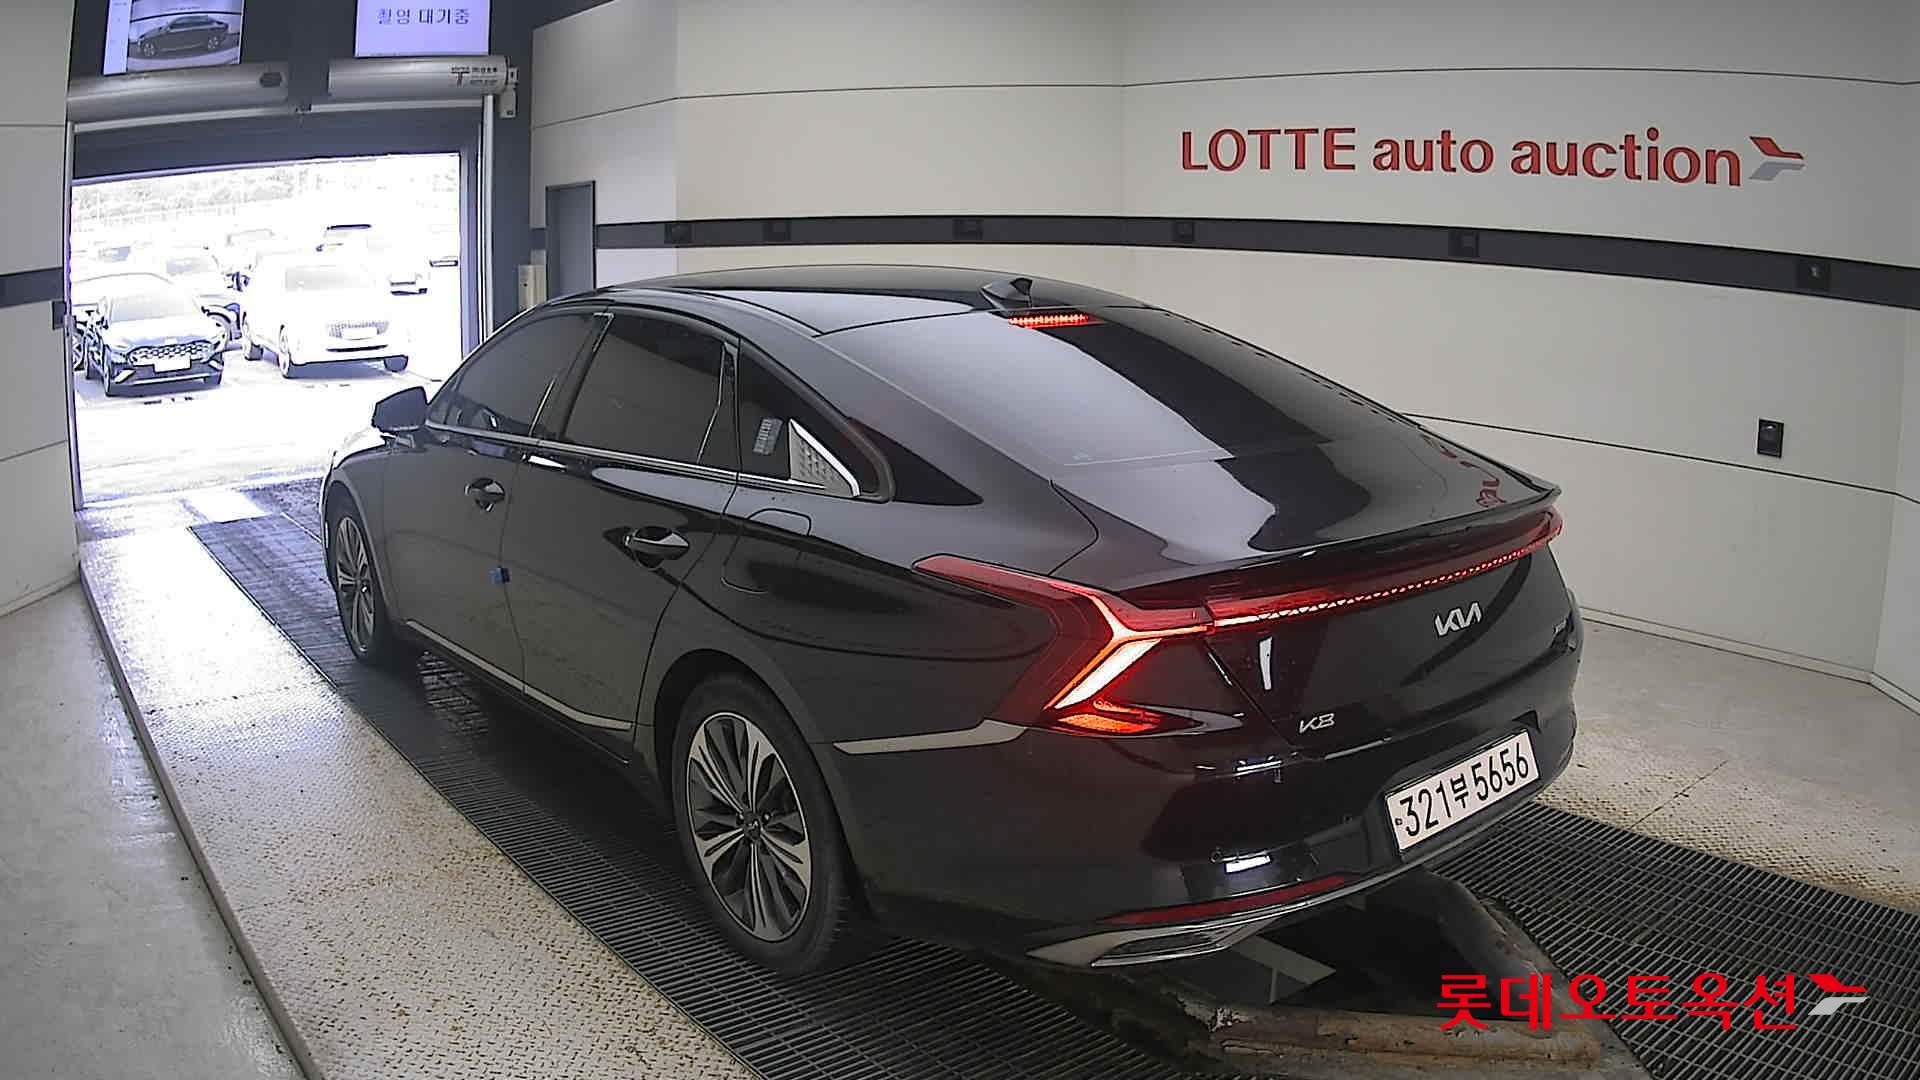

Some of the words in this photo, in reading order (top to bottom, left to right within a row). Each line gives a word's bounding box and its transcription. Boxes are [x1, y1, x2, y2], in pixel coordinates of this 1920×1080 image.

[418, 8, 471, 25] 대기중
[1182, 127, 1356, 171] LOTTE
[1372, 129, 1495, 174] auto
[1510, 127, 1742, 187] auction
[1434, 602, 1482, 636] KIA
